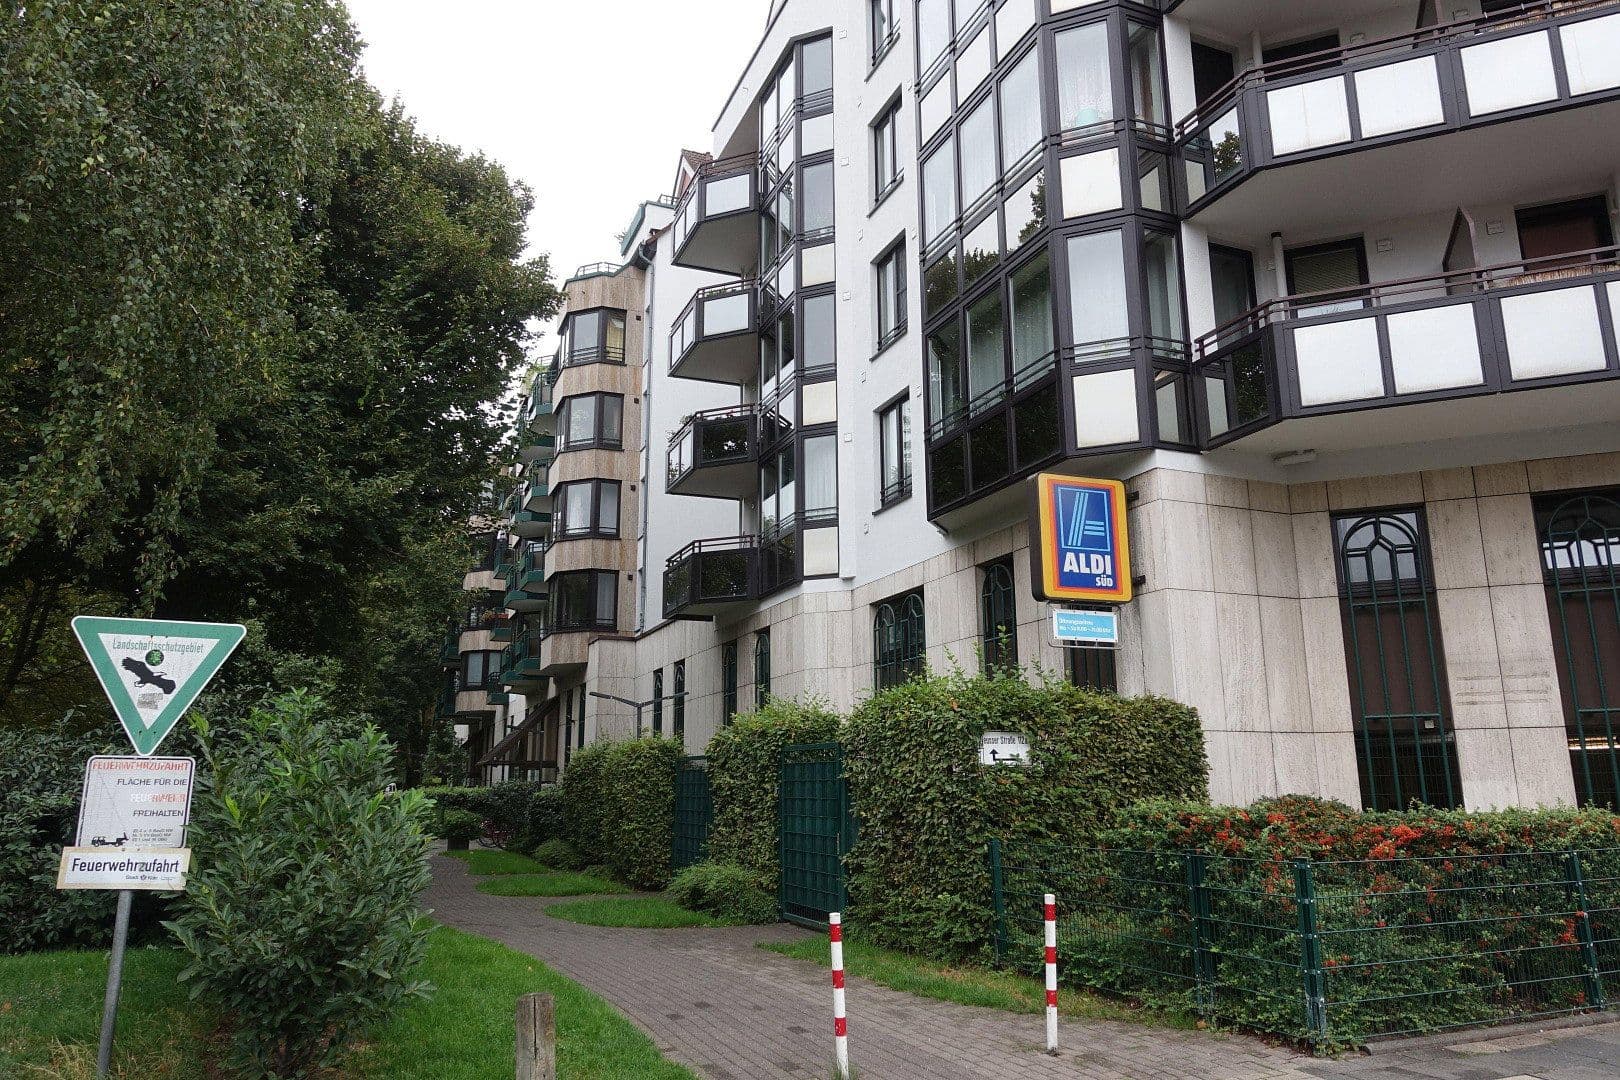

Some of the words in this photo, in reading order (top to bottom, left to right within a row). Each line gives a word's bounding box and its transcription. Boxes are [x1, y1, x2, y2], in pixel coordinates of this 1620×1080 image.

[1063, 551, 1112, 575] ALDI
[1095, 574, 1113, 587] SÜD
[112, 638, 204, 655] Landschaftsschutzgebiet
[154, 777, 172, 786] FÜR
[173, 778, 188, 786] DIE
[133, 809, 184, 817] FREIHALTEN
[71, 857, 180, 874] Feuerwehrzufahrt
